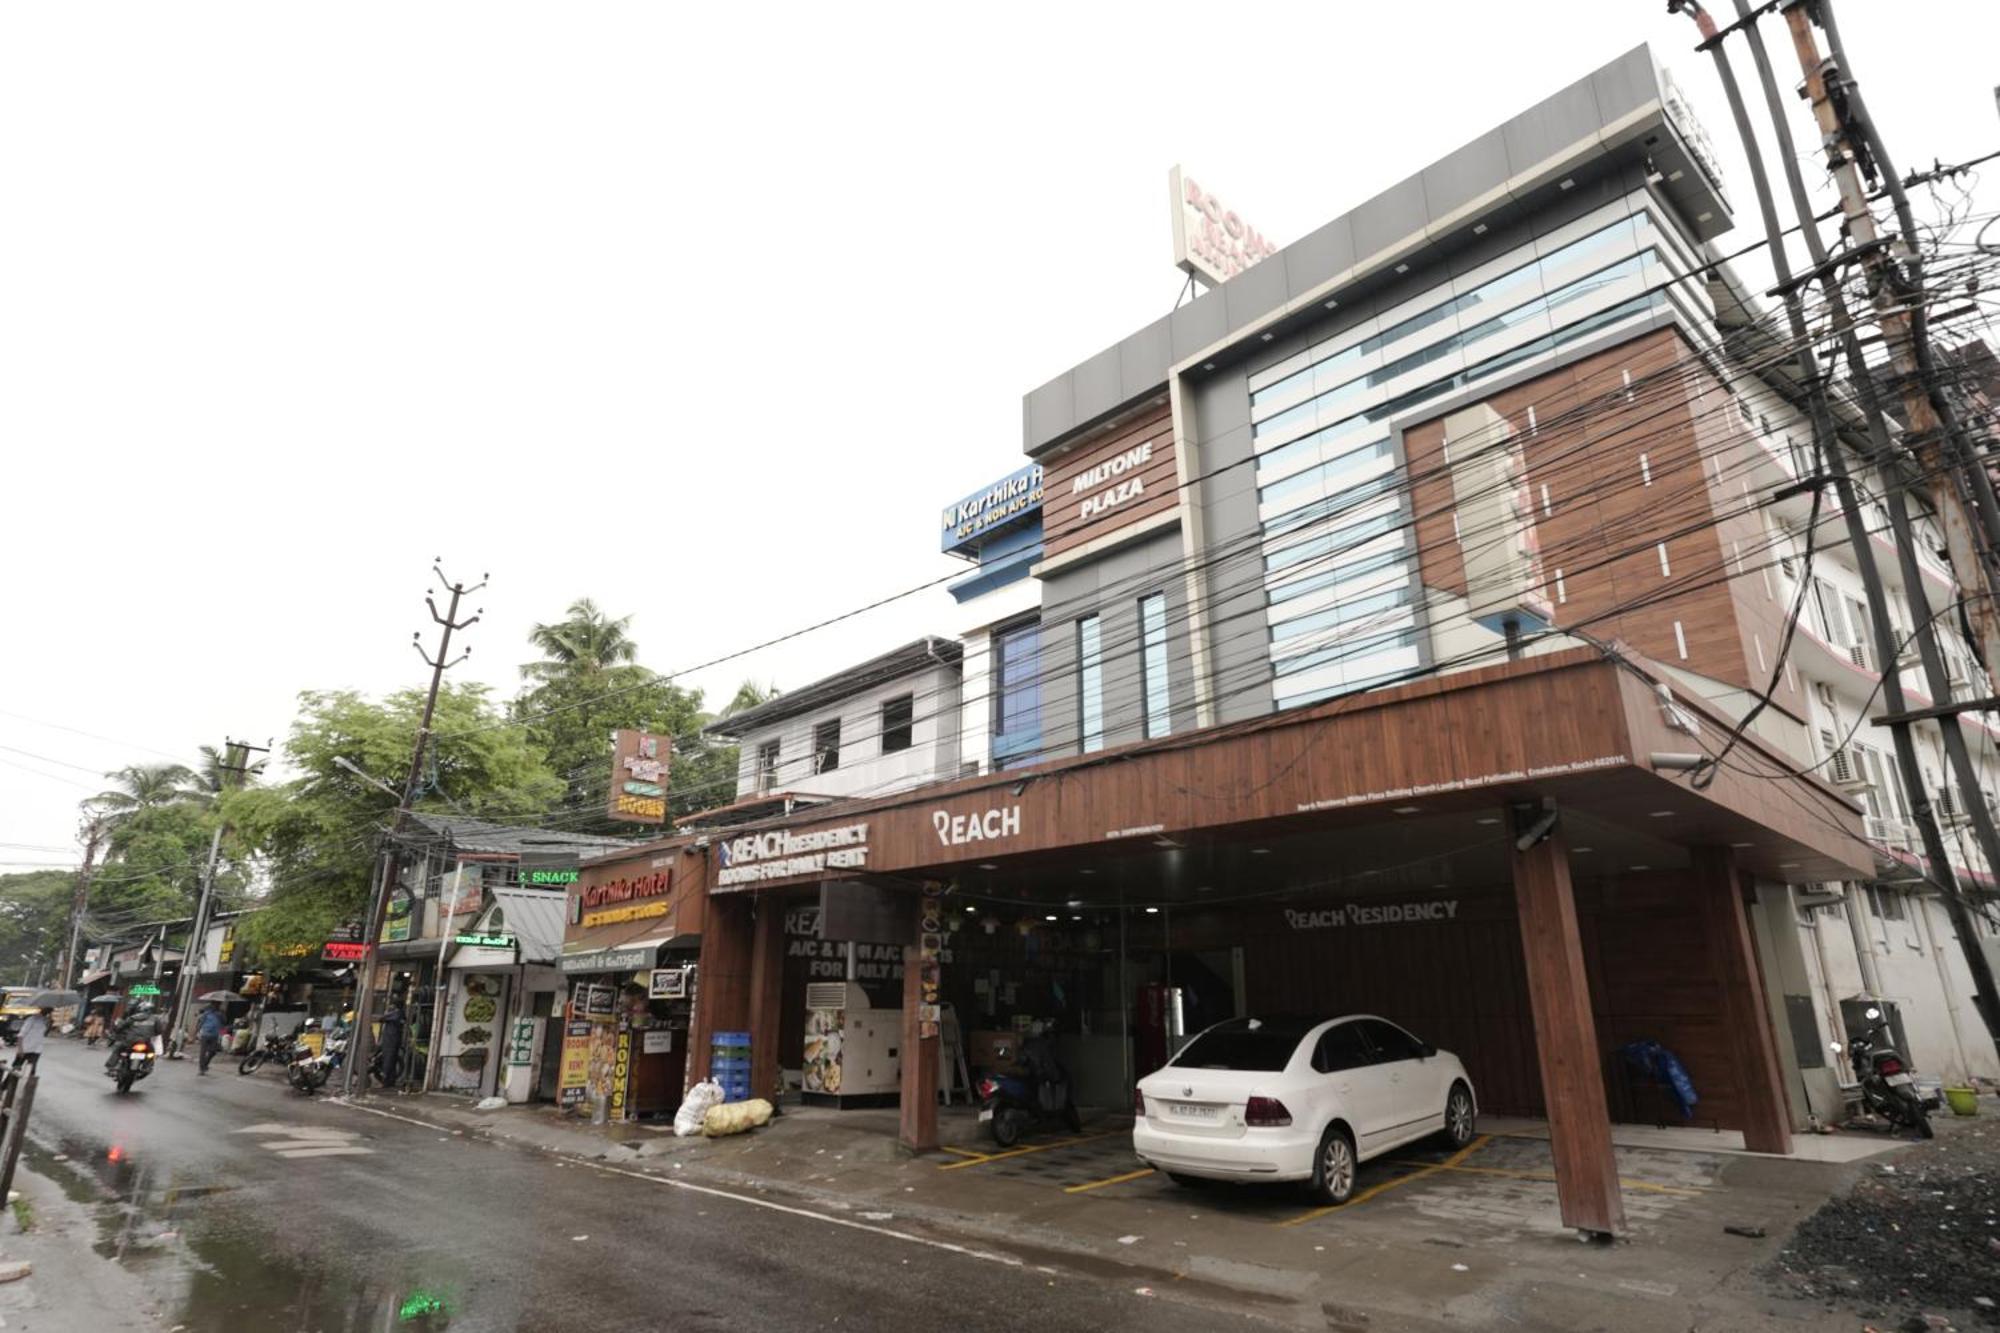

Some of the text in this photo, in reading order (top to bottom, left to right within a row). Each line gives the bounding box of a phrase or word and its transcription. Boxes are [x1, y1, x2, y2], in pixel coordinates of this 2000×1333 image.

[1072, 442, 1153, 494] MILTONE
[956, 523, 973, 538] A/C
[984, 505, 1007, 524] NON
[1008, 497, 1026, 513] A/C
[959, 476, 1028, 522] Karthika
[1080, 477, 1145, 519] PLAZA
[618, 794, 665, 817] ROOMS
[933, 805, 1021, 846] REACH
[732, 823, 868, 864] REACH RESIDENCY
[532, 872, 578, 883] SNACK
[583, 877, 635, 909] Karthika
[635, 868, 673, 897] Hotel
[1285, 900, 1458, 929] REACH RESIDENCY
[789, 941, 818, 957] A/C
[821, 942, 833, 957] &
[810, 961, 844, 977] FOR
[857, 963, 891, 978] AILY
[612, 1033, 629, 1108] ROOMS
